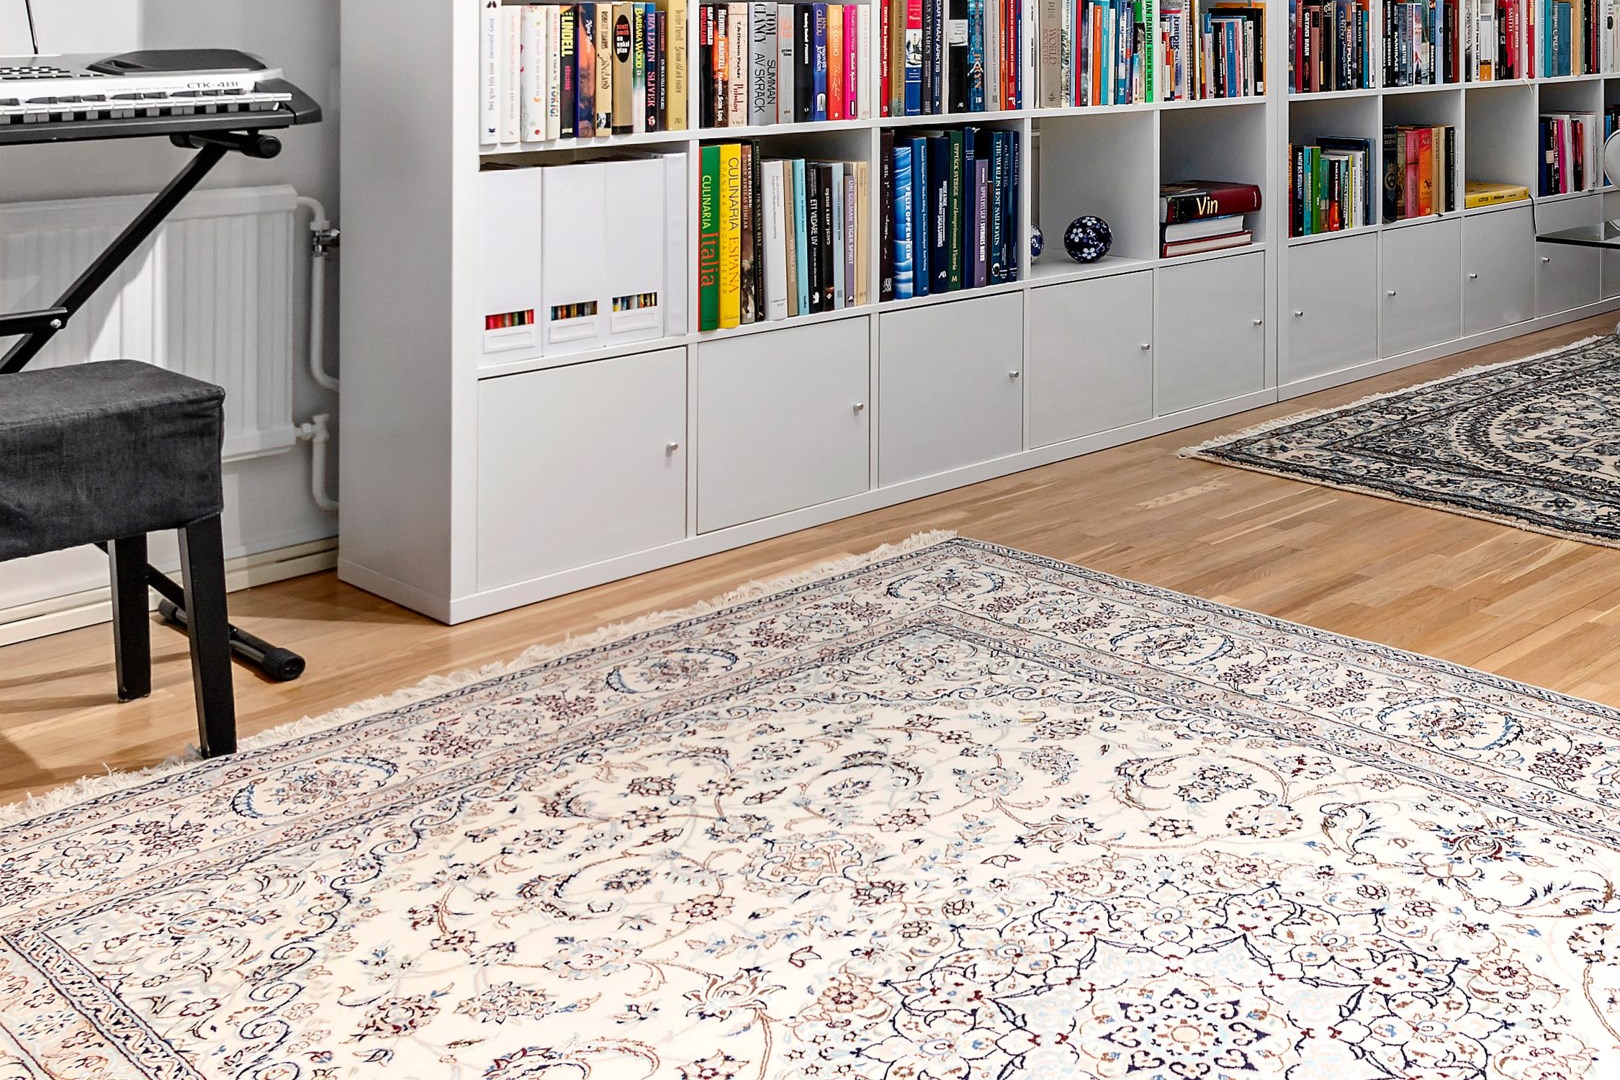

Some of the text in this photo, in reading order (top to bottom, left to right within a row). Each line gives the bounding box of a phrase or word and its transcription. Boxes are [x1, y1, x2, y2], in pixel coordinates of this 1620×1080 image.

[561, 17, 573, 57] LINDELL
[718, 9, 726, 39] HENNING
[754, 4, 765, 45] CLANCY
[766, 11, 775, 35] TOM
[926, 14, 931, 24] AV
[635, 43, 643, 68] WOOD
[647, 13, 655, 107] IRA LEVIN SLIVER
[754, 53, 766, 113] AV SKRÄCK
[767, 60, 775, 104] SUMMAN
[728, 158, 739, 231] CULINARIA
[1196, 197, 1218, 215] Vin
[701, 175, 719, 287] CULINARIA Italia
